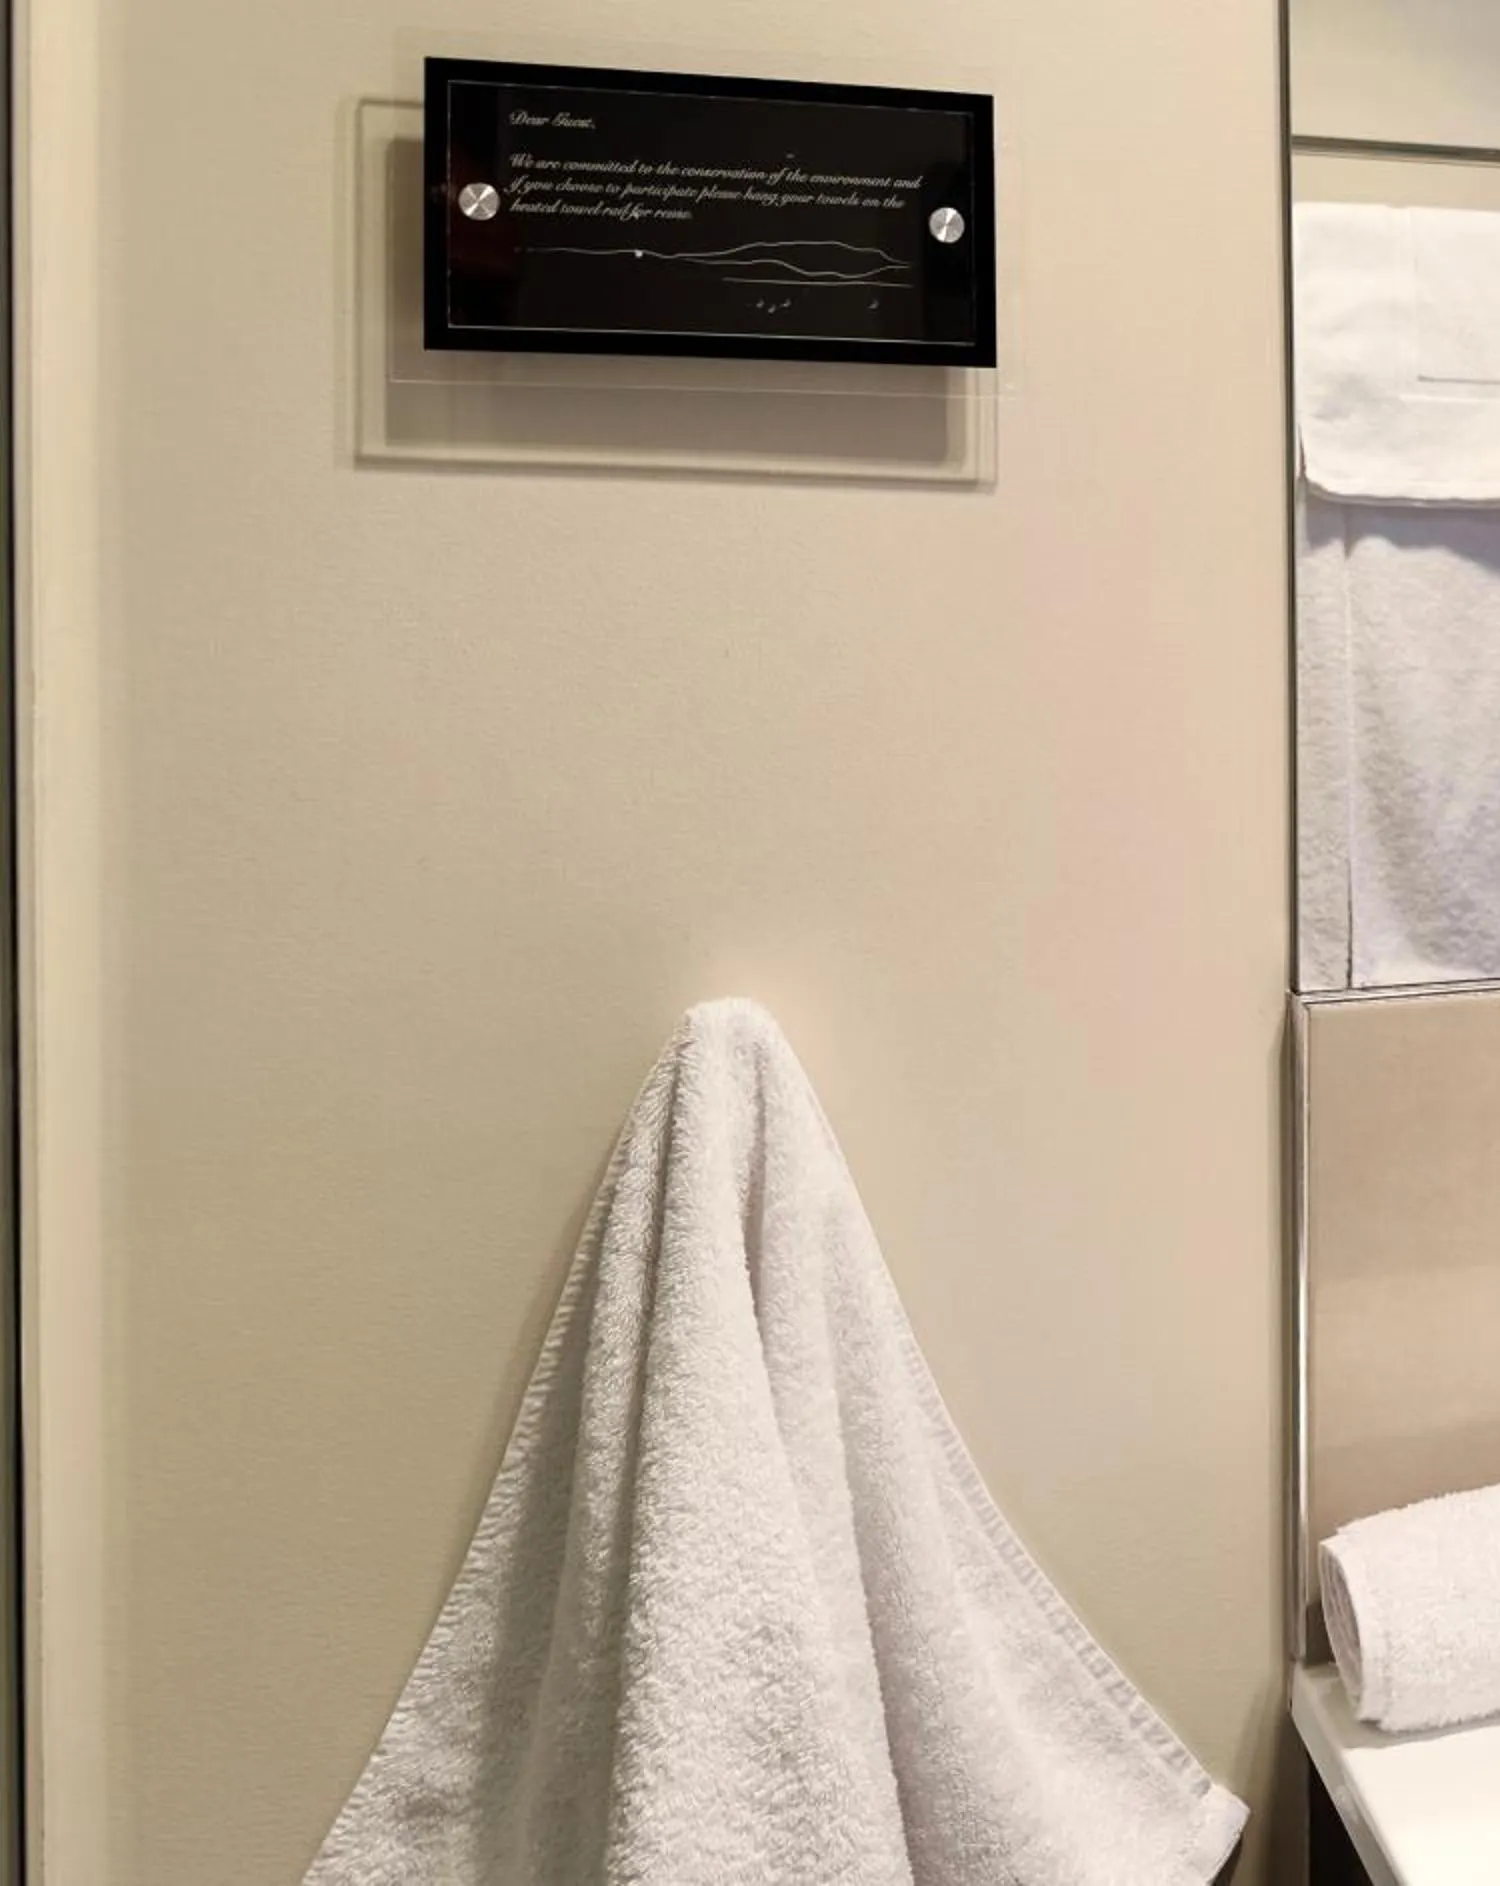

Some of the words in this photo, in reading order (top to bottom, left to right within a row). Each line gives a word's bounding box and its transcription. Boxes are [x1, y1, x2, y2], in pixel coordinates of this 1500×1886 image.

[509, 110, 549, 126] Dear
[509, 153, 534, 169] We
[535, 160, 560, 170] are
[563, 159, 640, 175] committed
[638, 163, 653, 175] to
[656, 161, 680, 175] the
[681, 167, 768, 179] conservation
[766, 167, 789, 185] of
[785, 168, 809, 183] the
[809, 174, 891, 188] environment
[893, 176, 923, 189] and
[523, 181, 554, 194] you
[555, 177, 604, 193] choose
[605, 183, 621, 193] to
[619, 183, 699, 202] participate
[695, 184, 742, 204] please
[743, 185, 778, 206] hang
[775, 193, 815, 207] your
[816, 191, 860, 206] towels
[861, 198, 881, 208] on
[882, 194, 906, 209] the
[509, 198, 562, 213] heated
[560, 201, 604, 216] towel
